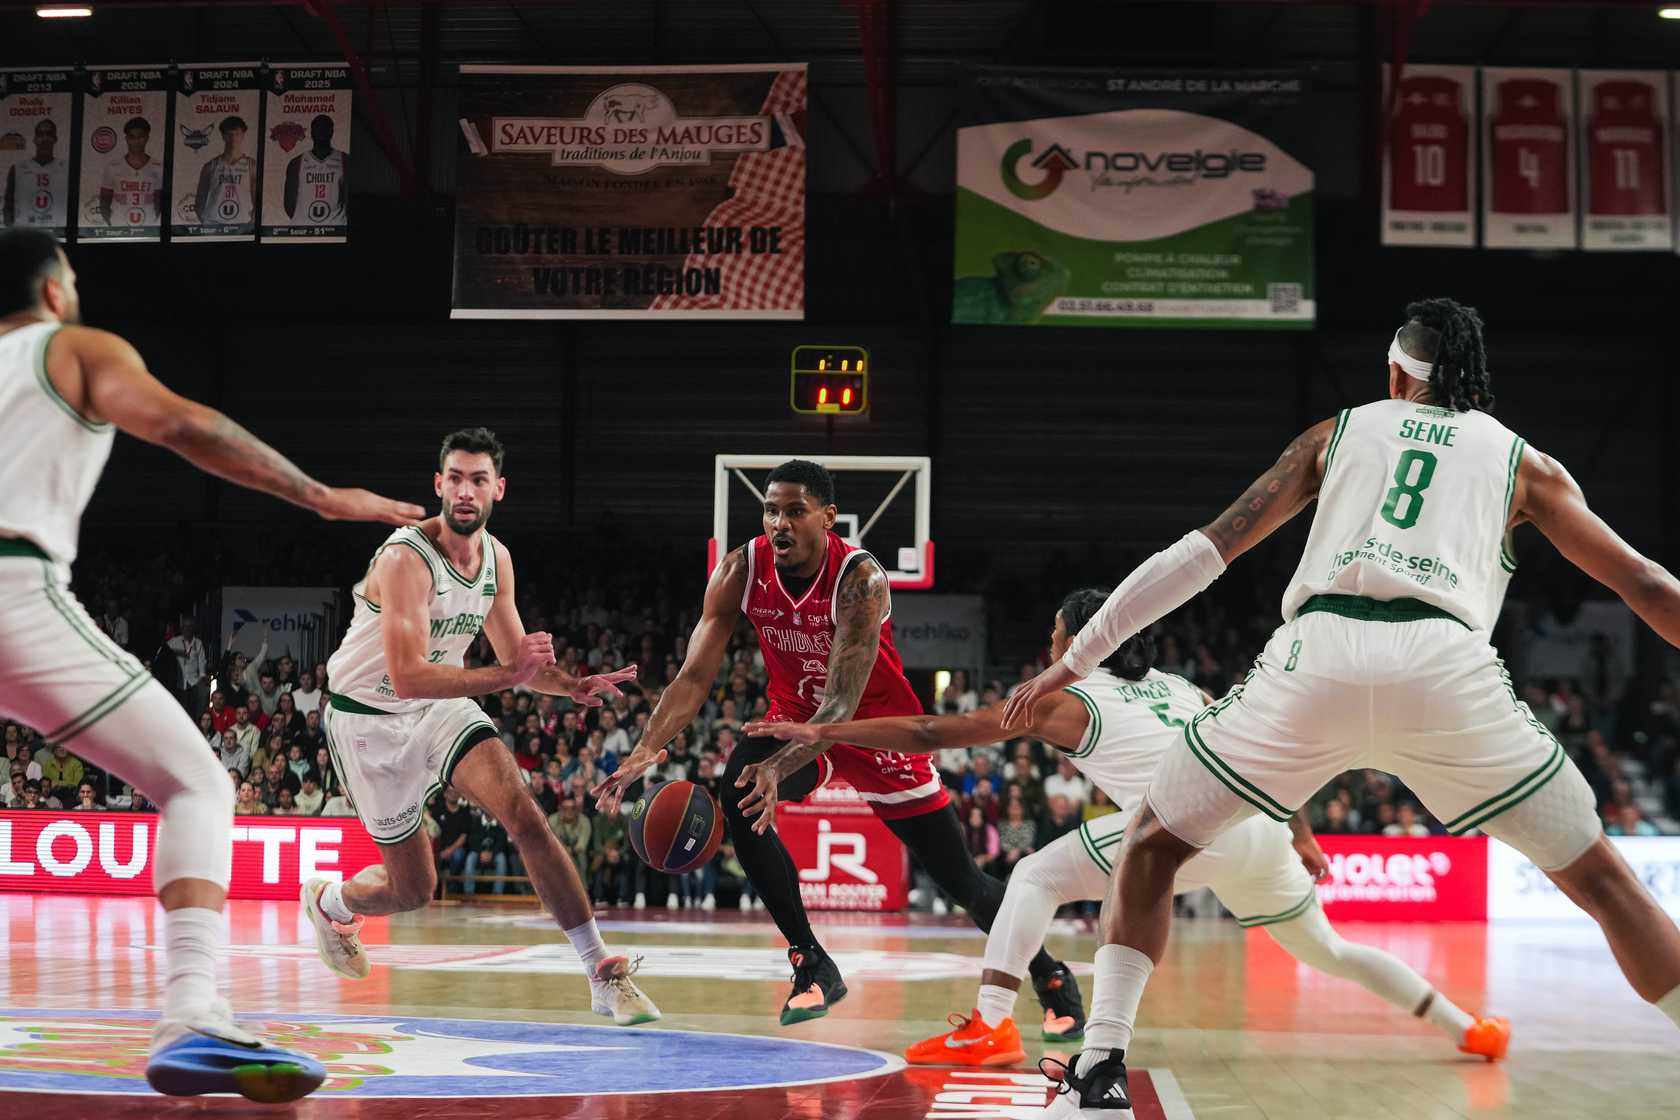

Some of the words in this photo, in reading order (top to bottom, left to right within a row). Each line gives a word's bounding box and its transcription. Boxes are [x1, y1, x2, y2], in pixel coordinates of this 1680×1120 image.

[13, 73, 43, 82] DRAFT
[45, 72, 67, 81] NBA
[107, 72, 137, 81] DRAFT
[139, 71, 162, 80] NBA
[199, 71, 230, 80] DRAFT
[233, 70, 255, 79] NBA
[290, 70, 321, 80] DRAFT
[324, 69, 347, 79] NBA
[120, 81, 147, 90] 2020
[212, 80, 239, 89] 2024
[303, 80, 331, 89] 2025
[1106, 79, 1127, 91] ST
[1185, 79, 1209, 91] DE
[1211, 79, 1231, 91] LA
[110, 95, 141, 105] Killian
[284, 94, 335, 104] Mohamed
[9, 107, 53, 117] GOBERT
[108, 105, 143, 115] HAYES
[282, 104, 336, 114] DIAWARA
[500, 123, 606, 146] SAVEURS
[614, 129, 648, 145] DES
[655, 122, 763, 145] MAUGES
[561, 148, 626, 161] traditions
[629, 148, 645, 161] de
[649, 147, 702, 164] l'Anjou
[1412, 144, 1446, 188] 10
[1517, 145, 1540, 189] 4
[1612, 148, 1640, 190] 11
[36, 173, 50, 187] 15
[313, 185, 327, 199] 12
[585, 227, 611, 255] LE
[619, 227, 742, 255] MEILLEUR
[751, 227, 783, 254] DE
[534, 267, 617, 296] VOTRE
[1399, 418, 1459, 448] SENE
[1381, 449, 1438, 530] 8
[1283, 639, 1303, 672] 8
[0, 820, 343, 885] LOUTE
